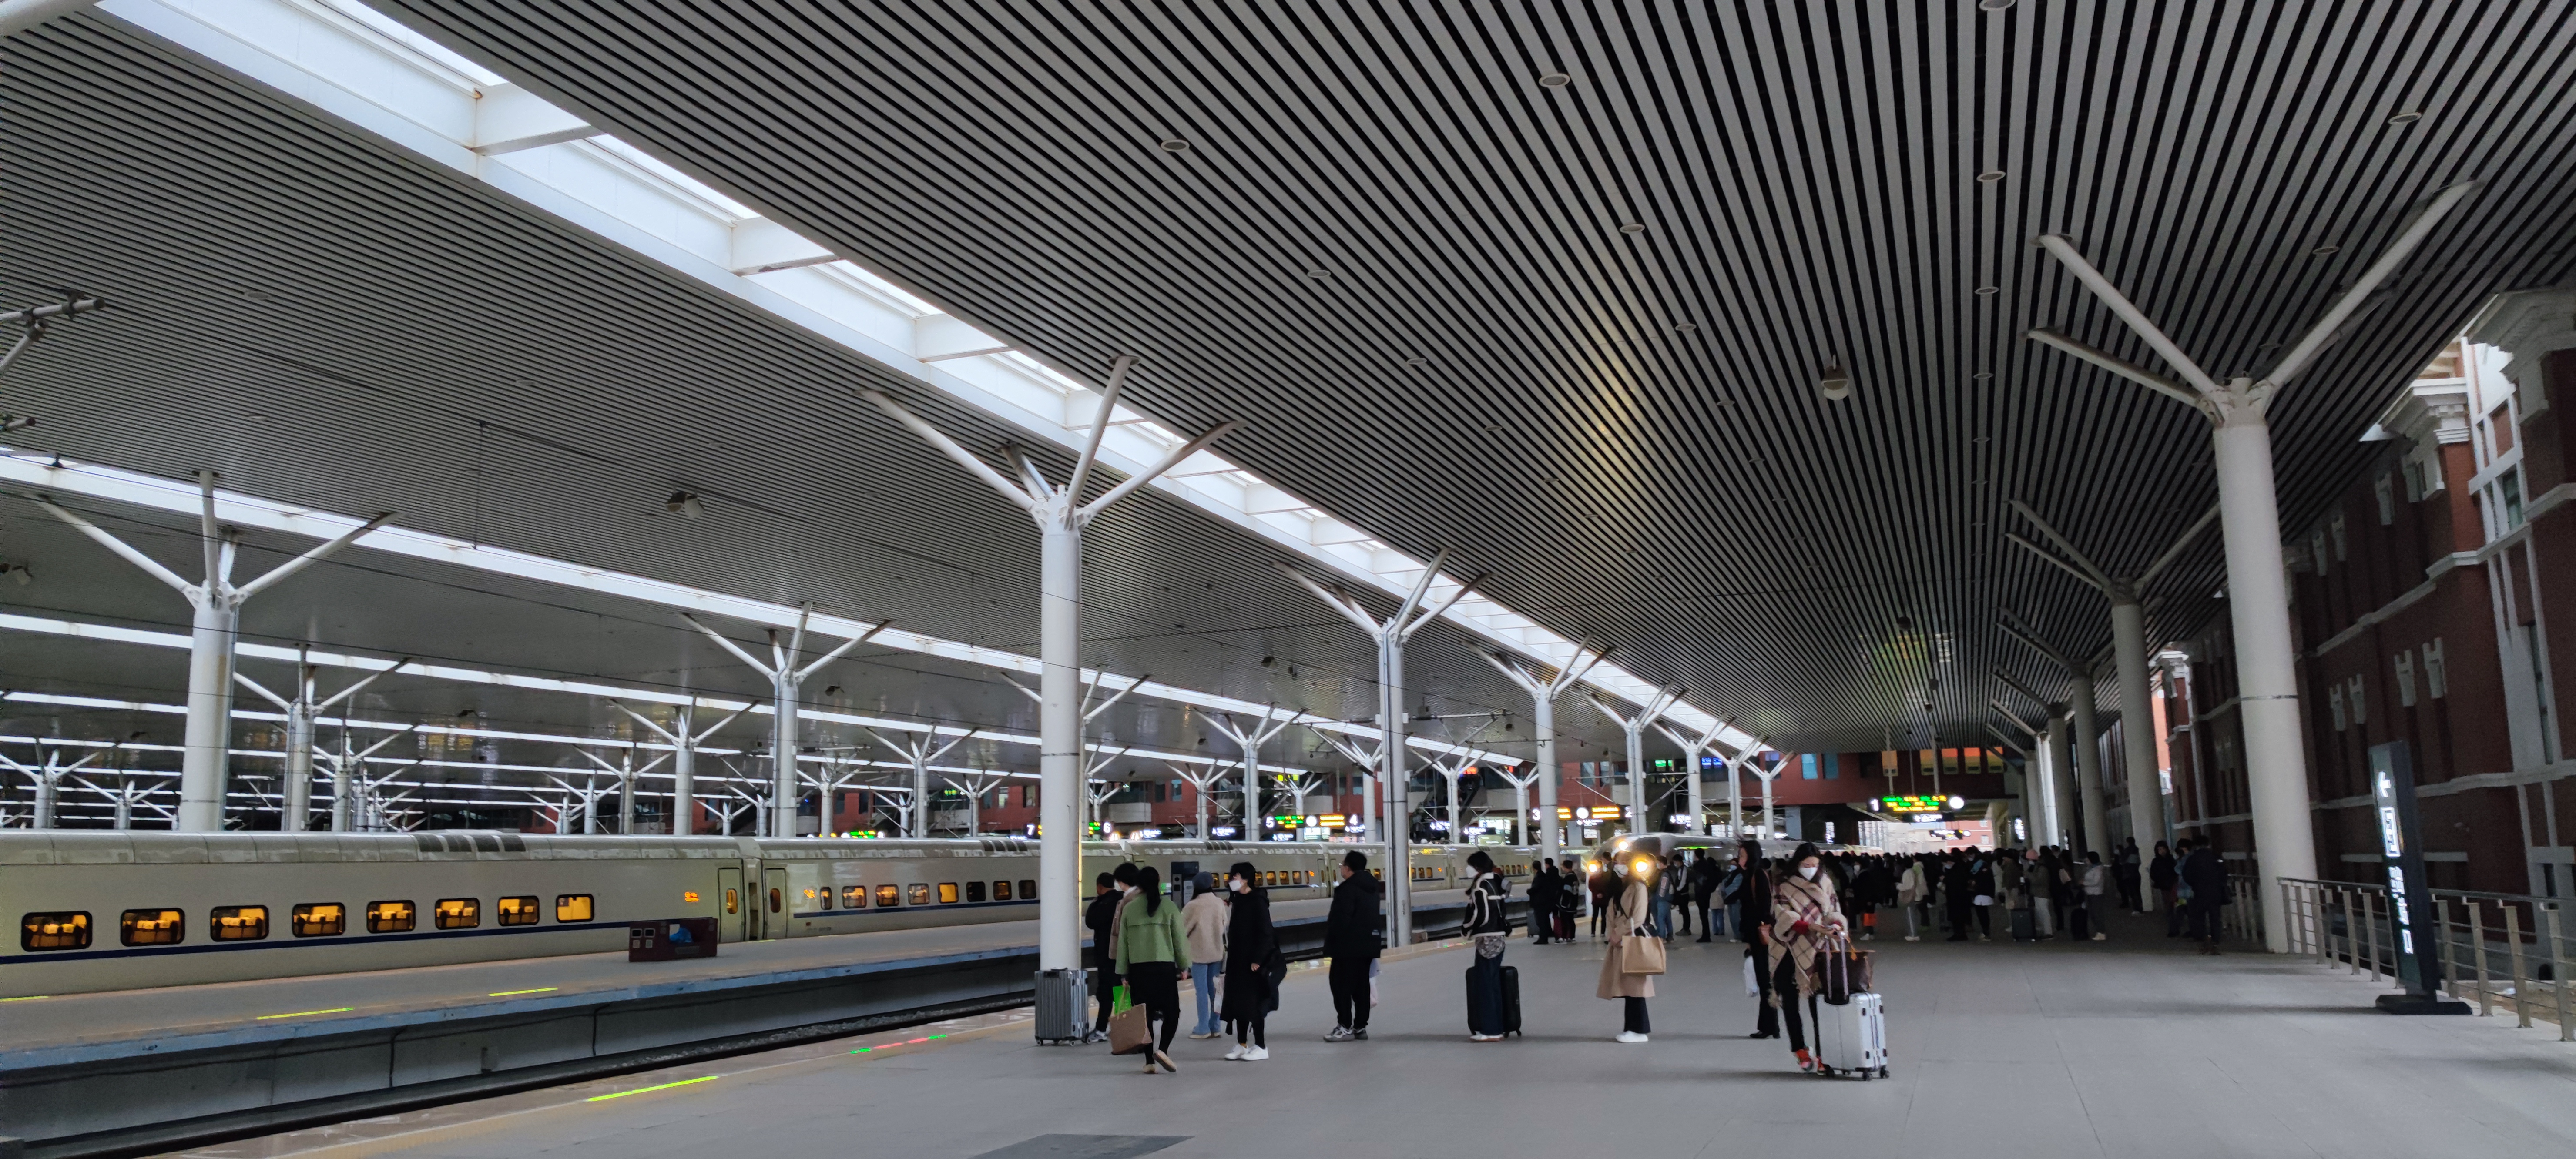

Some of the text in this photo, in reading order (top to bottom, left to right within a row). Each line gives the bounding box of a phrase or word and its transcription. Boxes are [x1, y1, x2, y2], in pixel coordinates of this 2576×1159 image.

[1870, 799, 1879, 811] 1
[1349, 814, 1358, 825] 4
[1532, 808, 1541, 821] 3
[1103, 822, 1111, 833] 6
[1266, 816, 1275, 828] 5
[1026, 824, 1034, 835] 7
